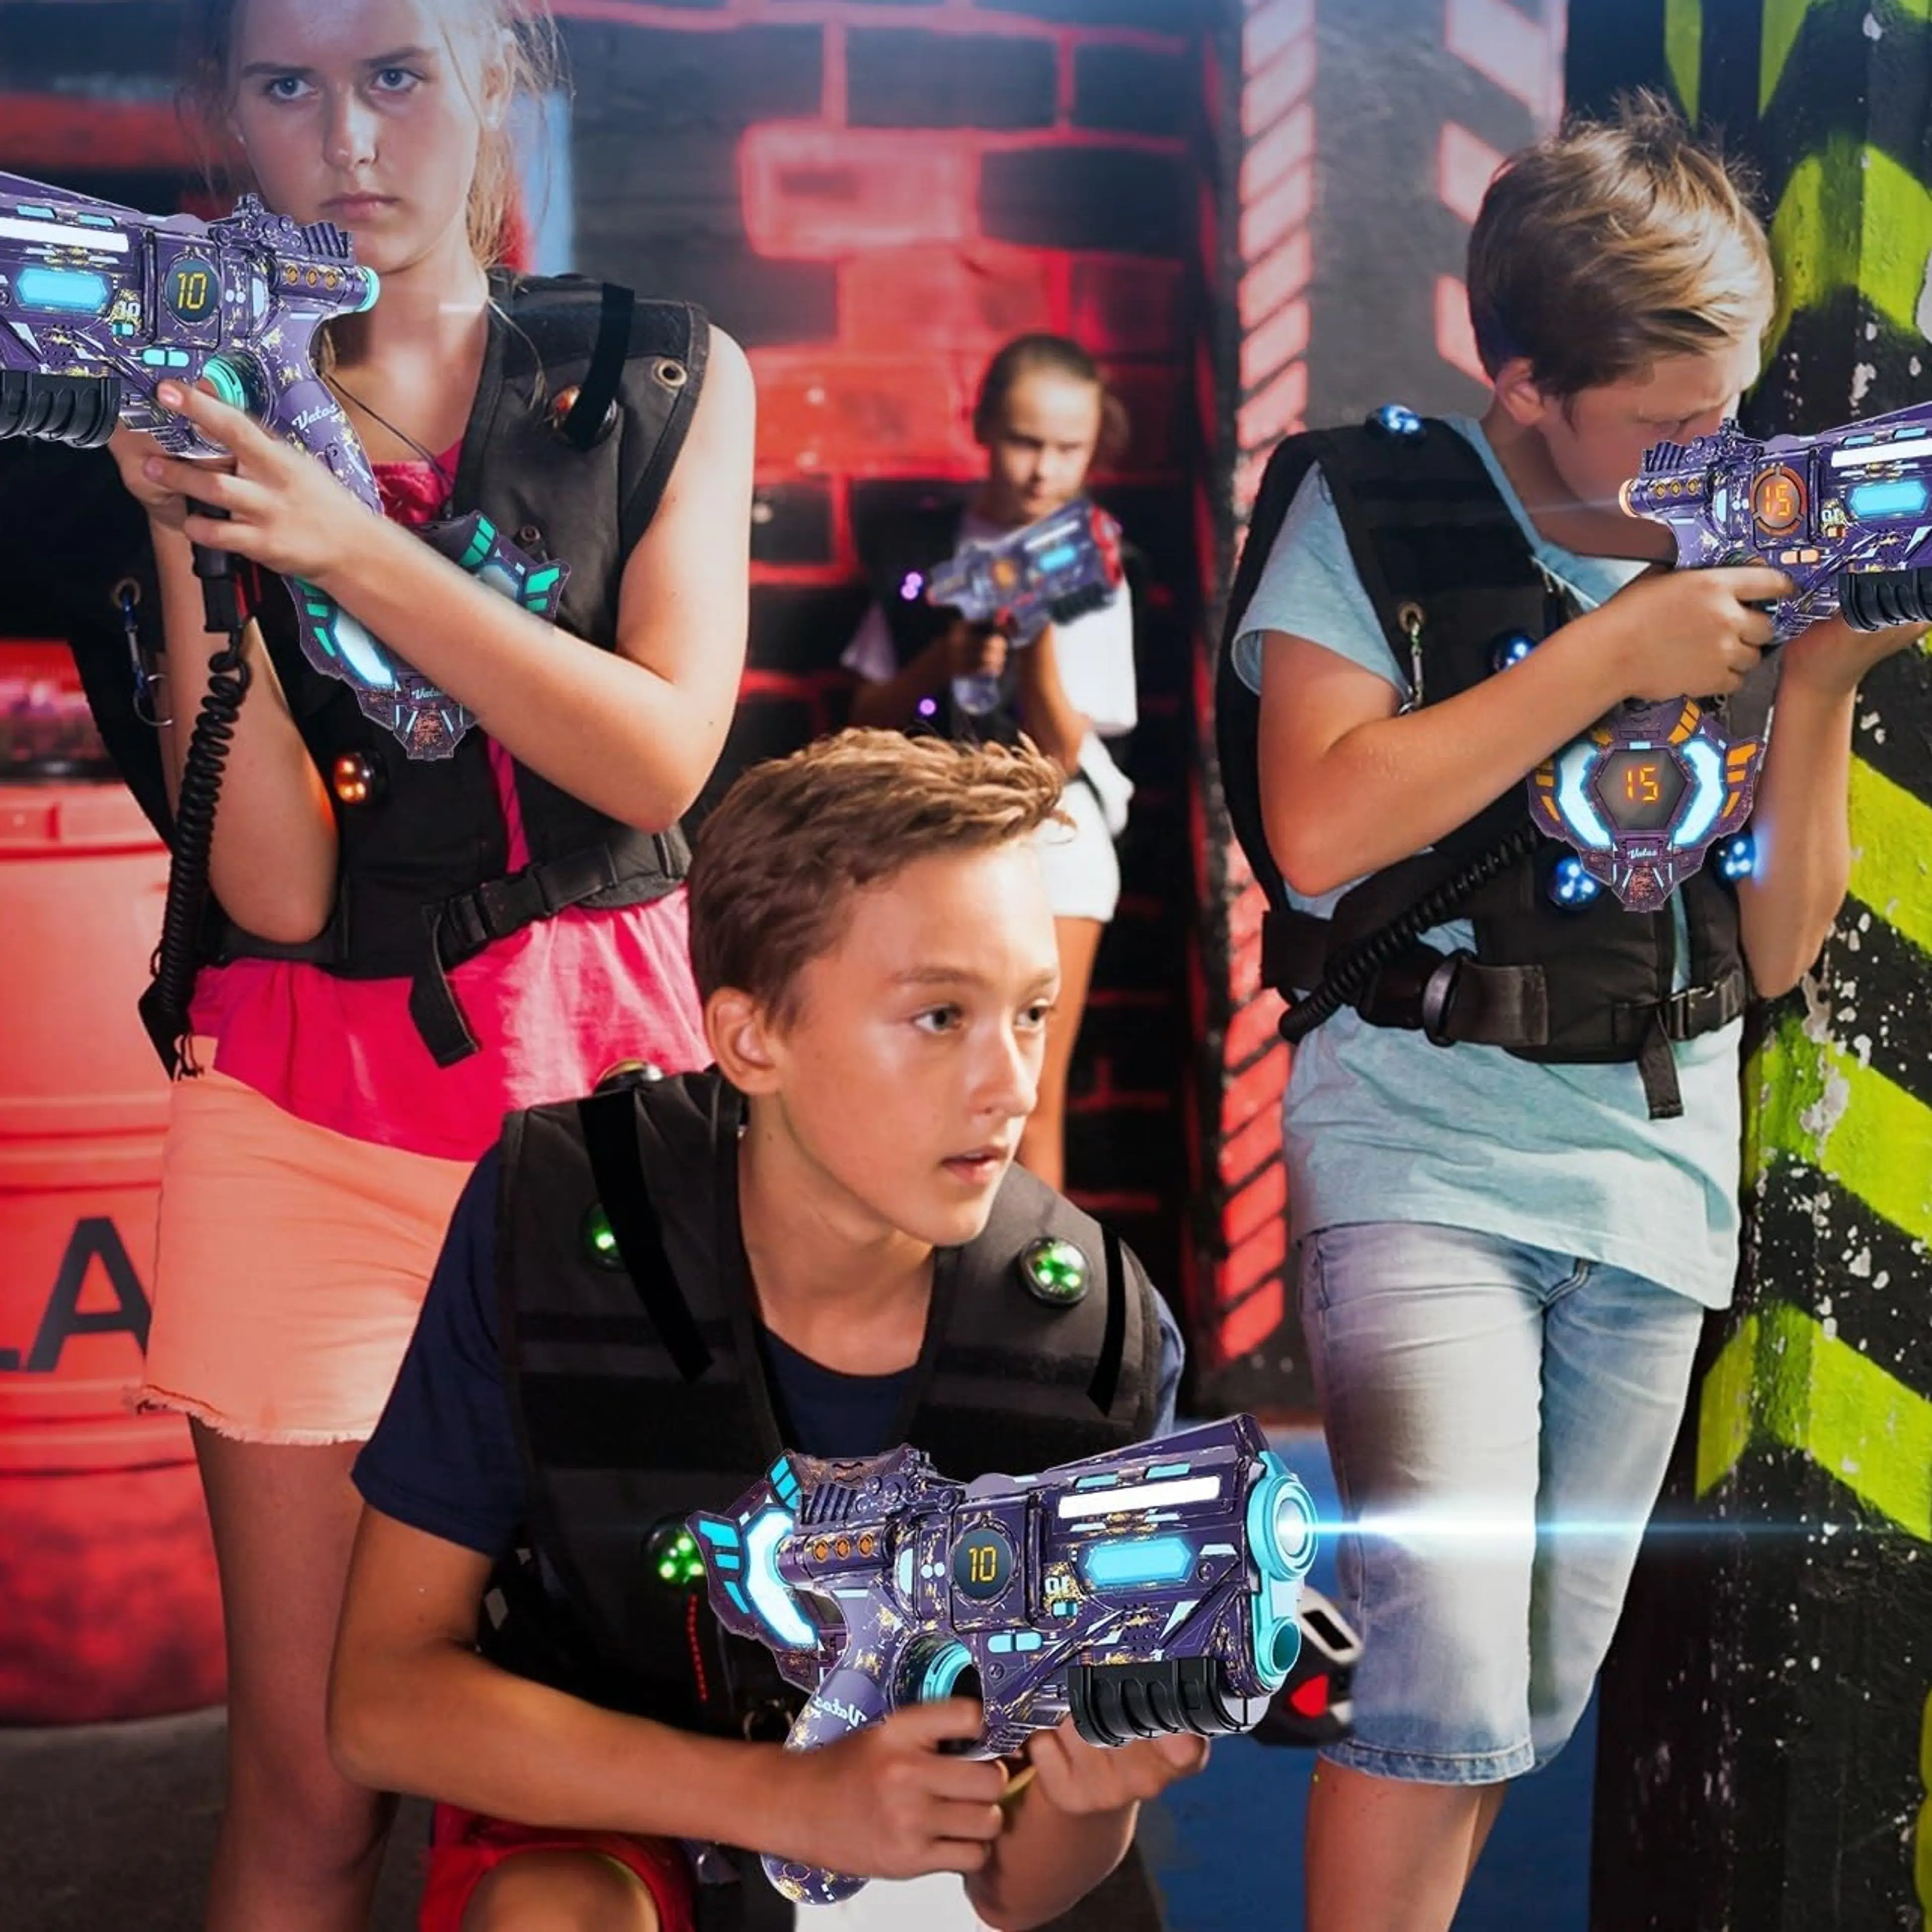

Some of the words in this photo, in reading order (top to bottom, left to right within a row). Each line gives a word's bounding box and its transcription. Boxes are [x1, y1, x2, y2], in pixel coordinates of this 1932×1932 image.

[178, 272, 207, 309] 10
[291, 403, 338, 430] Vatos
[1765, 485, 1790, 517] 15
[1627, 767, 1658, 800] 15
[0, 1216, 152, 1373] A
[969, 1546, 997, 1582] 10
